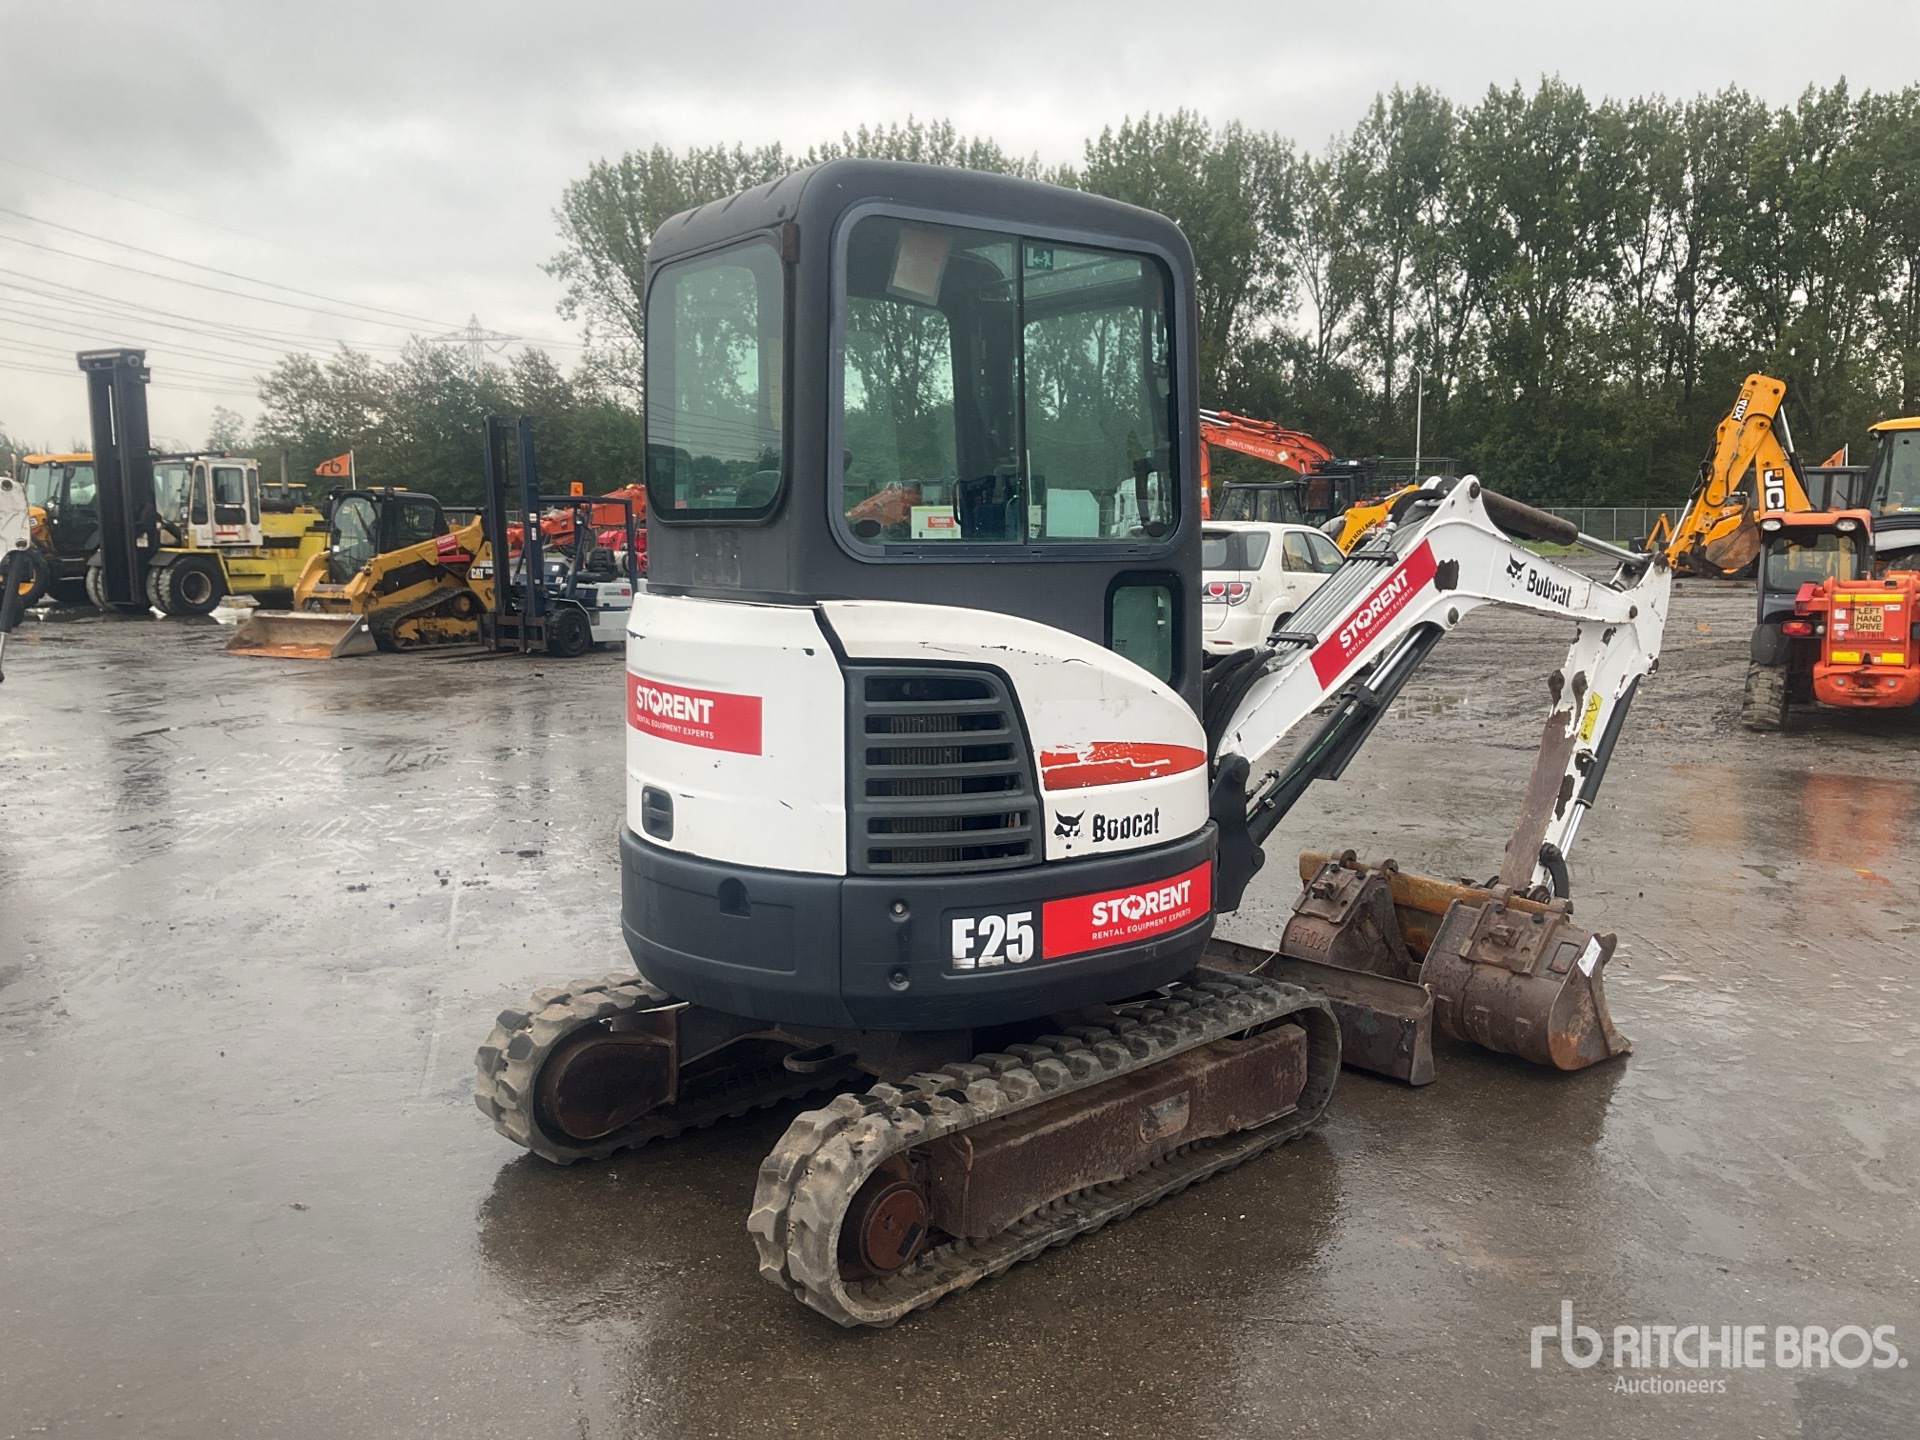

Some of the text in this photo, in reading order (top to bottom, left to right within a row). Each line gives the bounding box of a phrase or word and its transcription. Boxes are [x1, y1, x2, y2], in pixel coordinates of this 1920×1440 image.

[1764, 470, 1785, 512] JC
[1343, 539, 1355, 552] NEW
[1352, 517, 1377, 540] HOLLAND
[471, 568, 484, 579] CAT
[1526, 568, 1572, 608] Bobcat
[1339, 568, 1408, 649] STORENT
[1345, 586, 1414, 659] RENTAL EQUIPMENT EXPERTS
[1856, 615, 1882, 623] HAND
[1858, 607, 1880, 615] LEFT
[1855, 622, 1882, 631] DRIVE
[636, 685, 714, 724] STORENT
[636, 713, 715, 740] RENTAL EQUIPMENT EXPERTS
[1092, 807, 1159, 842] Bobcat
[1092, 879, 1191, 926] STORENT
[952, 911, 1034, 969] E25
[1092, 907, 1191, 940] RENTAL EQUIPMENT EXPERTS
